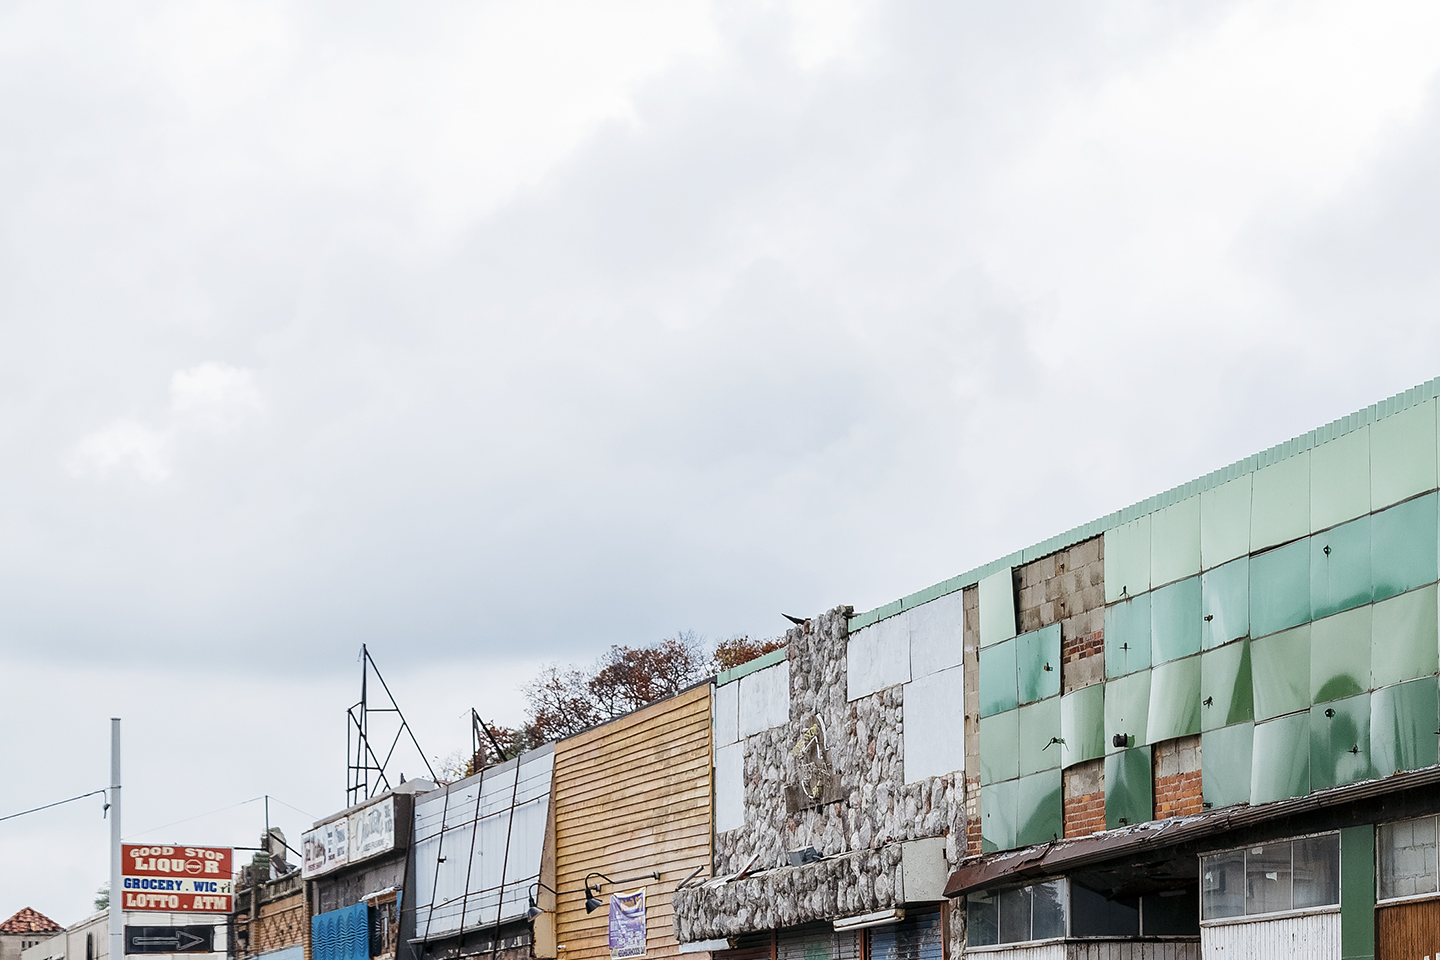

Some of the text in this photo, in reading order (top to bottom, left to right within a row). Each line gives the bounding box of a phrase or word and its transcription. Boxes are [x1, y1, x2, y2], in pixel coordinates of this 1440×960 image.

[130, 846, 224, 861] GOOD STOP
[124, 878, 217, 893] GROCERY WIC
[126, 893, 227, 910] LOTTO ATM
